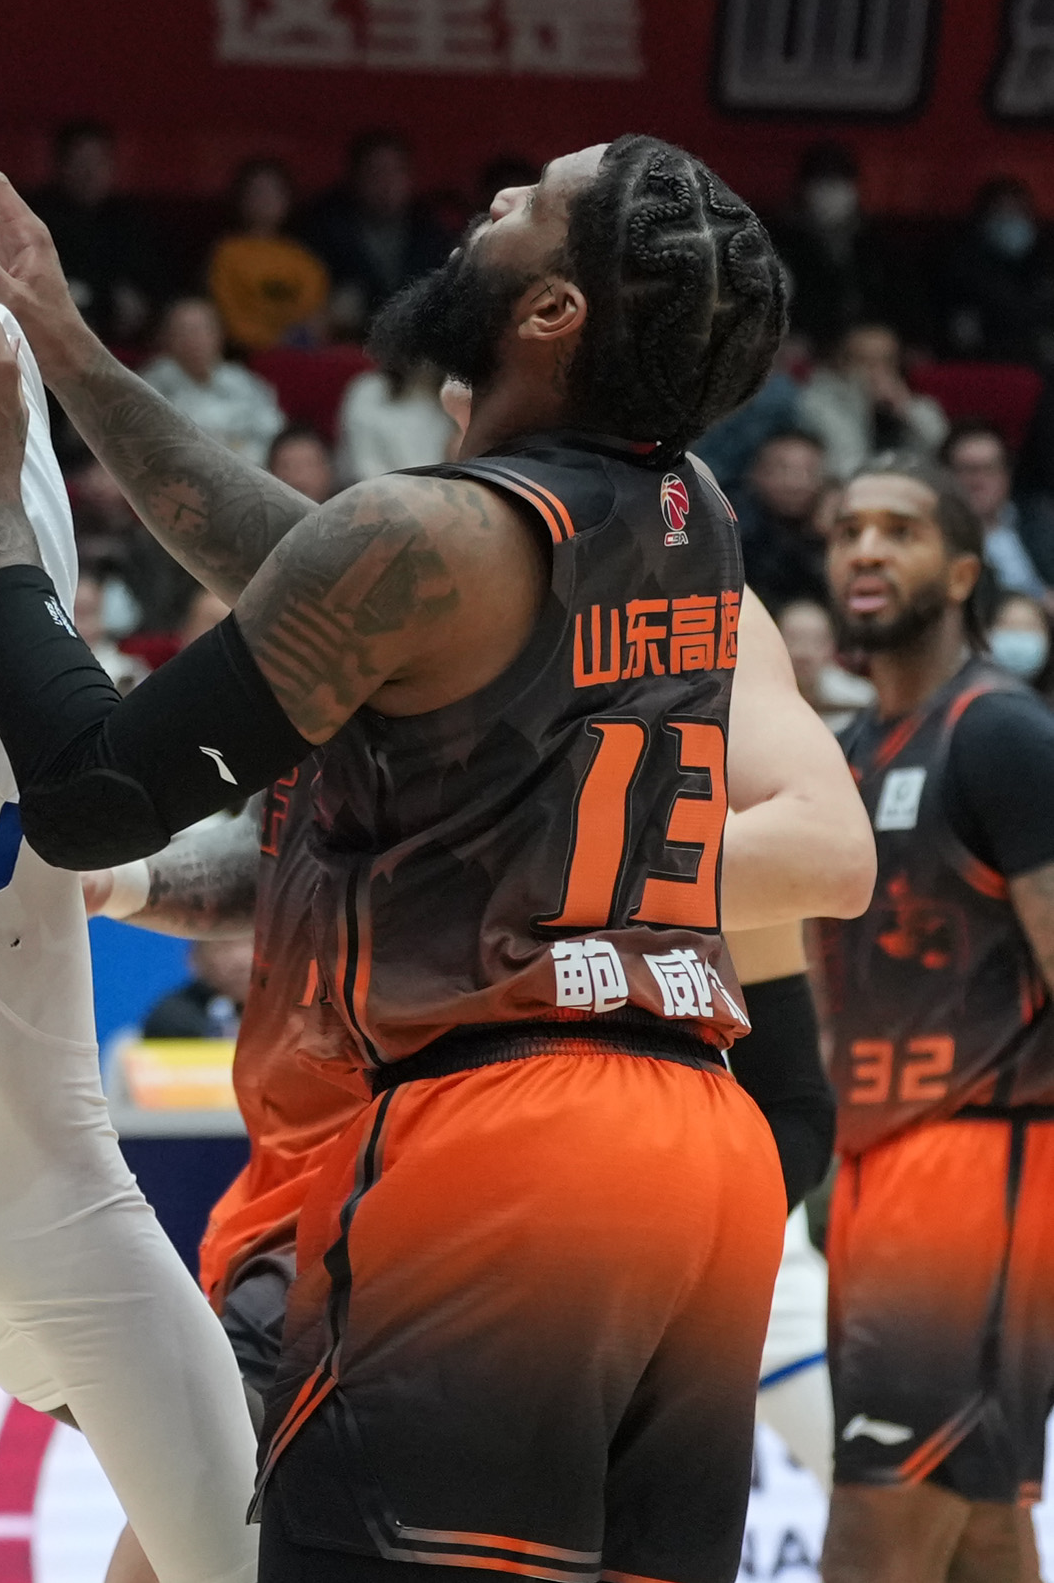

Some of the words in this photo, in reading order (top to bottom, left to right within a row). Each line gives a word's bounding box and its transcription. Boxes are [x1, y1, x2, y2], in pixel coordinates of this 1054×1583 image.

[664, 531, 689, 547] CBA
[532, 719, 729, 932] 13
[850, 1035, 956, 1105] 32
